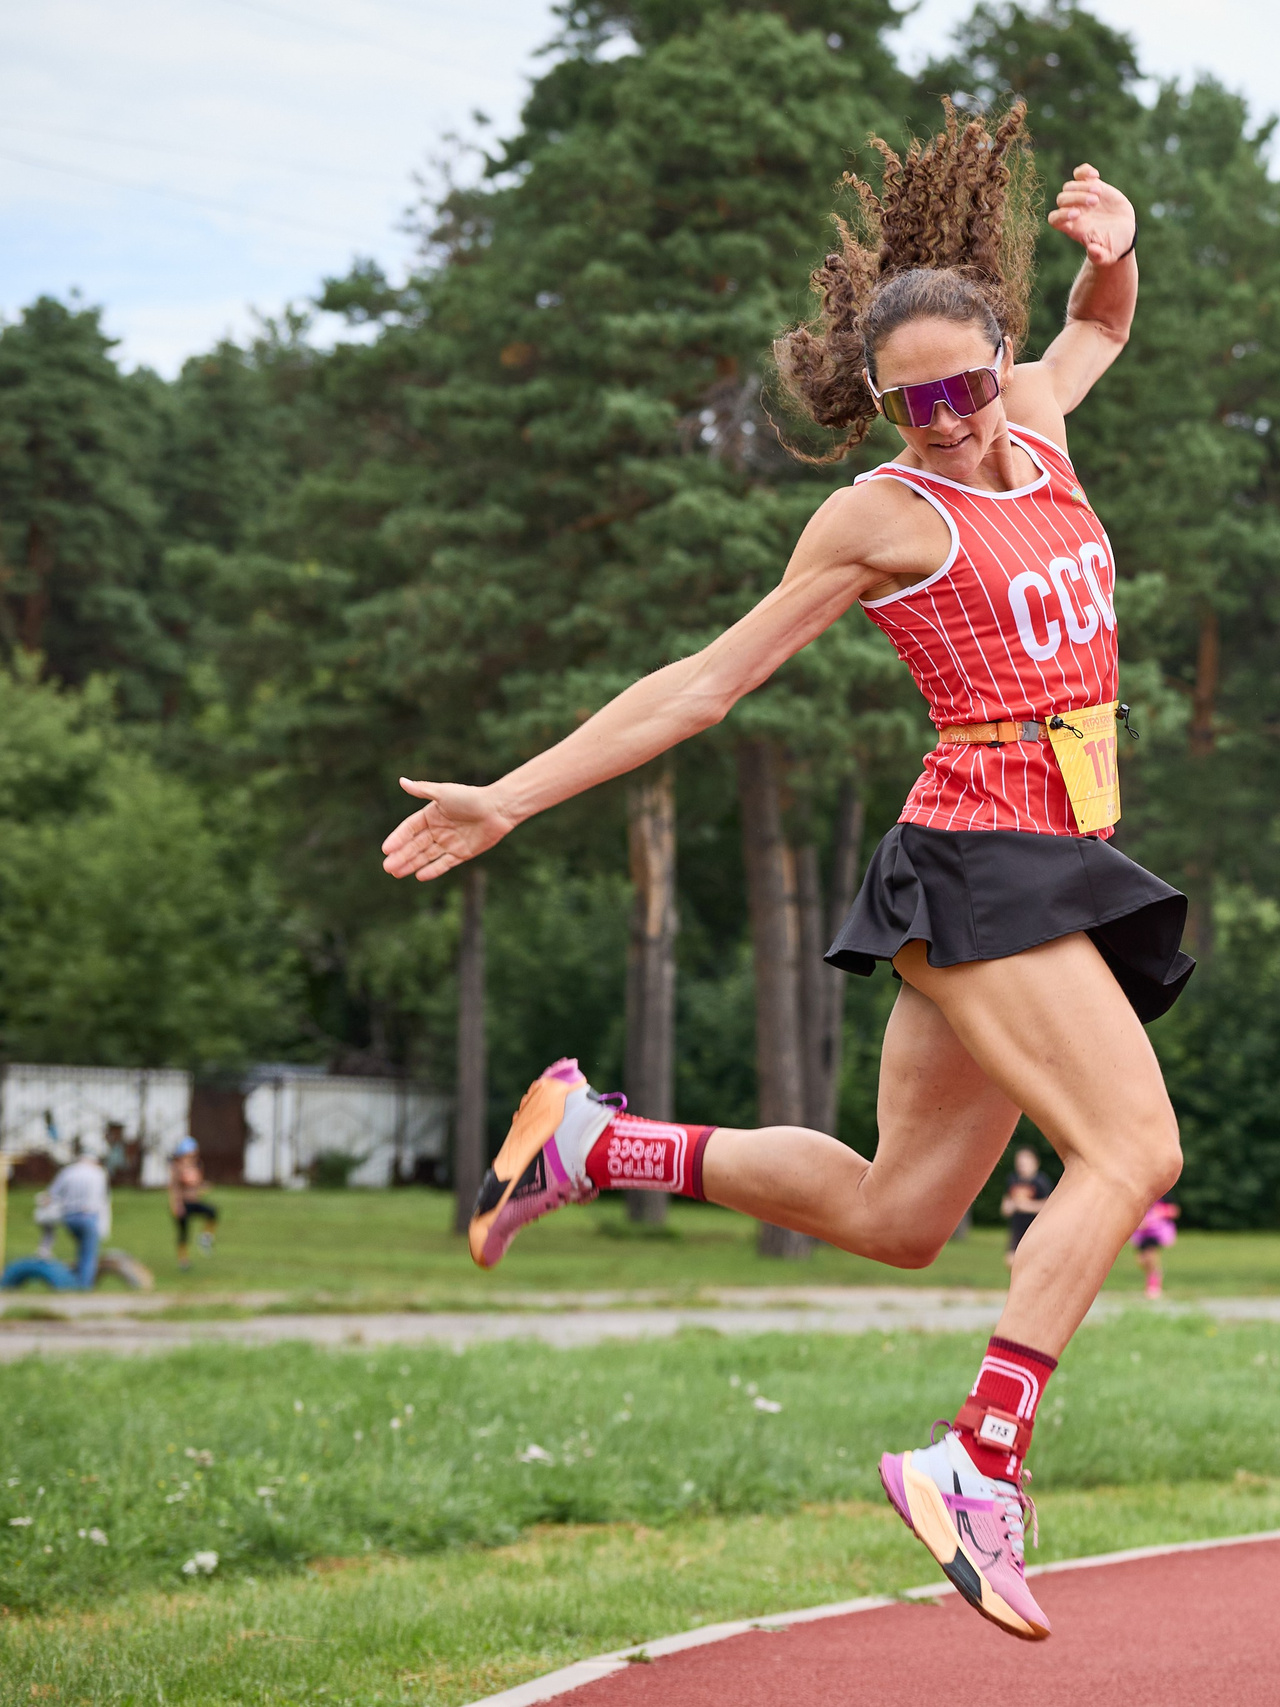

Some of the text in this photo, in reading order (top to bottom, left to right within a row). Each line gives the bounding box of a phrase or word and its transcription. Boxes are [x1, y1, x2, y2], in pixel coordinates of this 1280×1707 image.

[1007, 533, 1117, 661] ССС
[607, 1137, 667, 1162] КРОСС
[607, 1156, 665, 1180] РЕТРО
